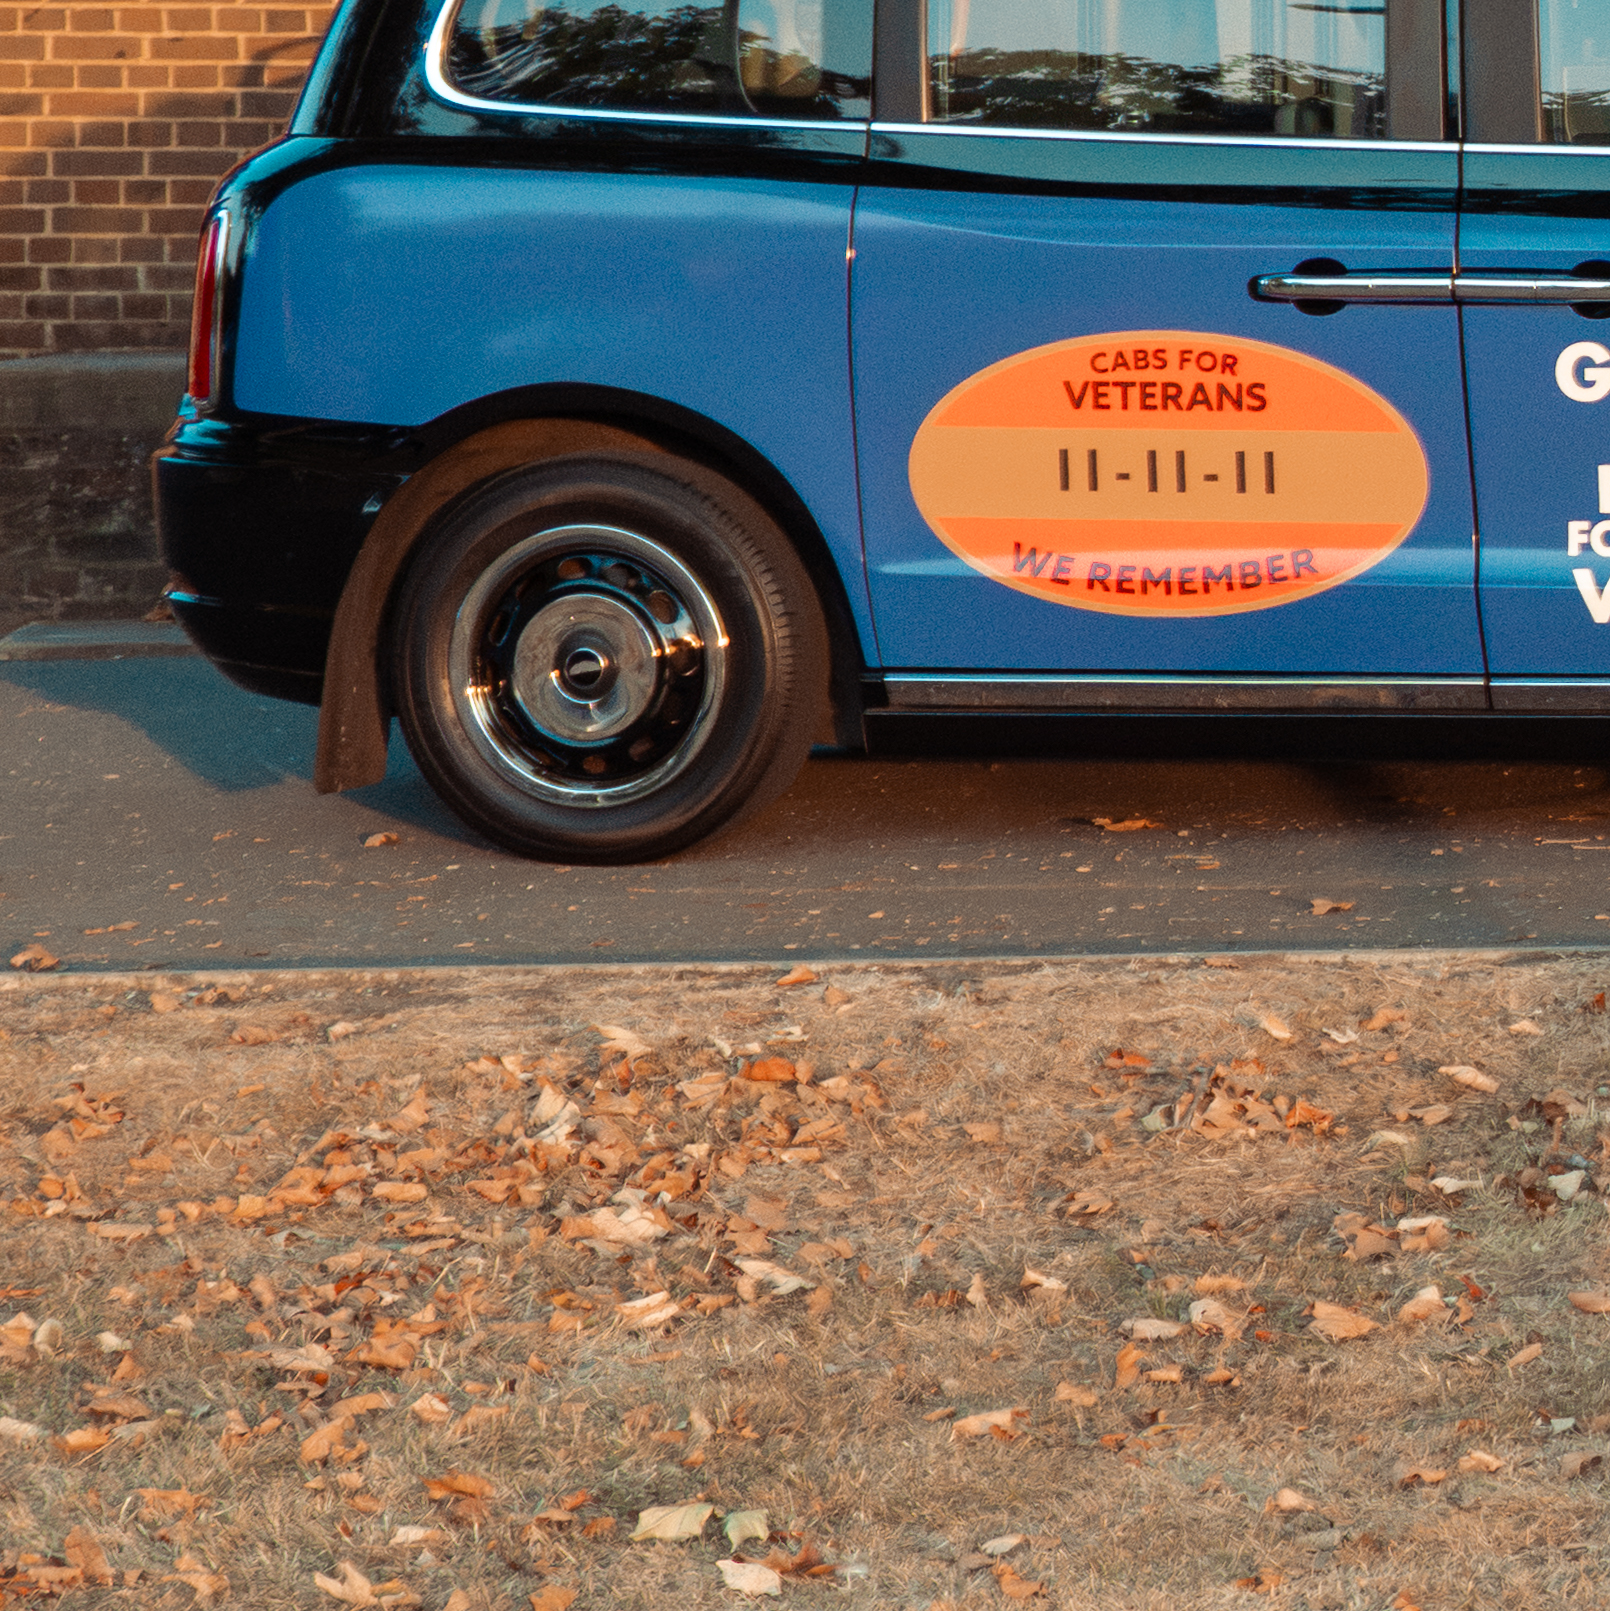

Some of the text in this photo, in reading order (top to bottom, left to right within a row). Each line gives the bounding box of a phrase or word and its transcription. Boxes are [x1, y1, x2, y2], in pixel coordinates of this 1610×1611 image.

[1090, 349, 1239, 376] CABS FOR
[1063, 381, 1268, 412] VETERANS
[1058, 448, 1275, 494] 11-11-11
[1013, 542, 1319, 596] WE REMEMBER
